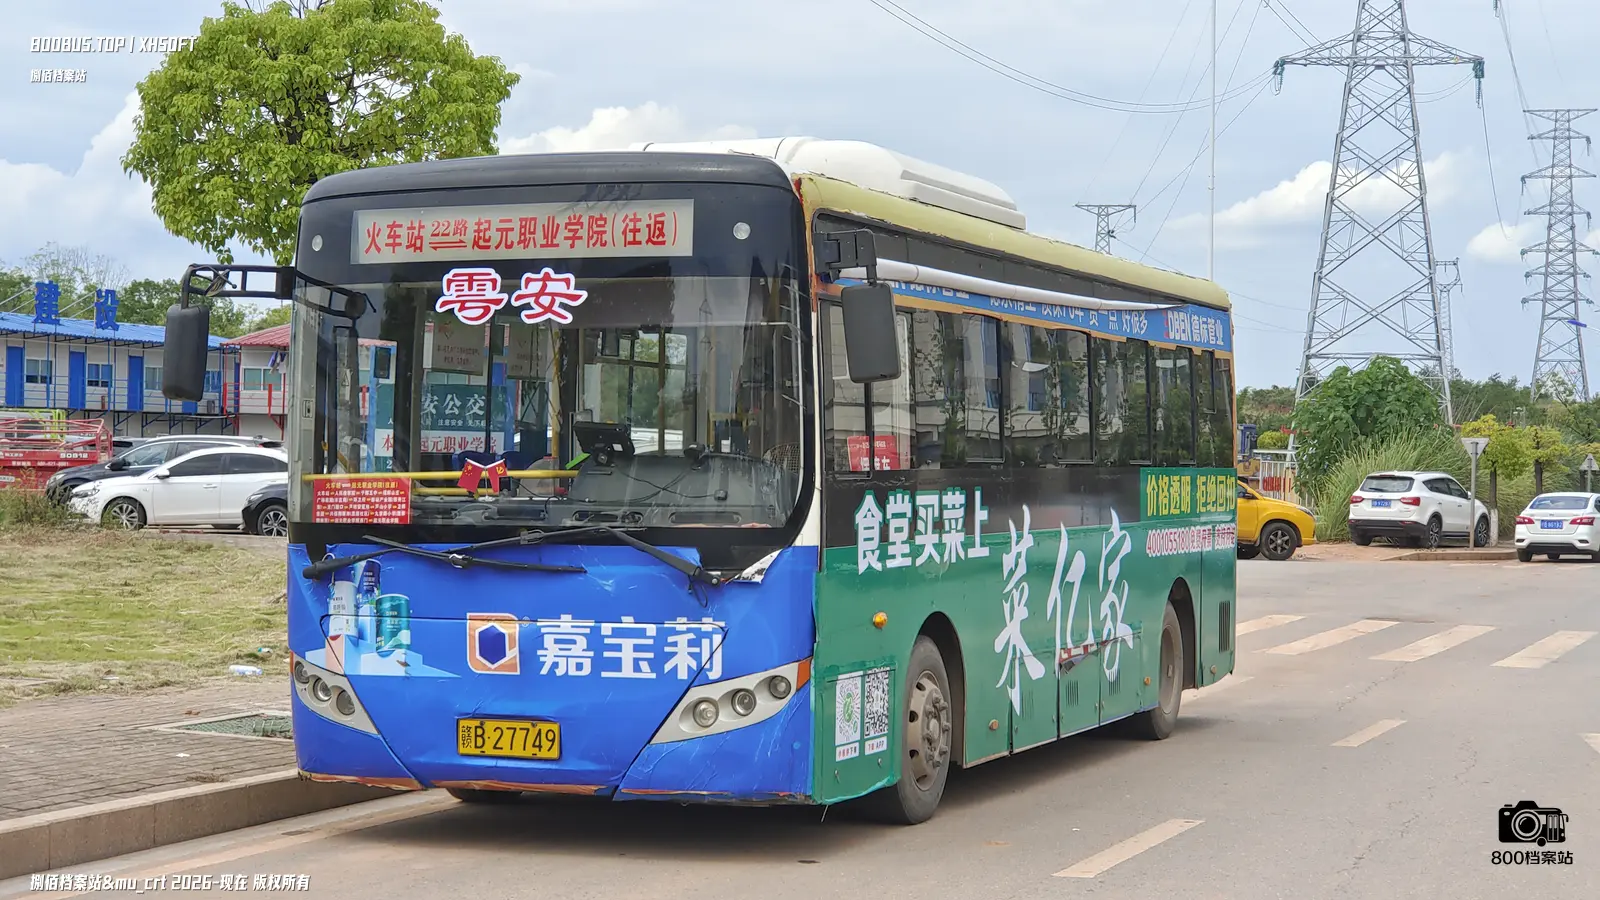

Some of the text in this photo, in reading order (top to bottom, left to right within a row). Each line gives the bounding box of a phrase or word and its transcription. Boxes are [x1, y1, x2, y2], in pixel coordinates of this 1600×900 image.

[364, 211, 678, 255] 火车站 22路 起元职业学院(往返)
[1147, 474, 1236, 517] 价格透明 拒绝回扣
[854, 487, 990, 576] 食堂买菜上
[536, 614, 727, 681] 嘉宝莉
